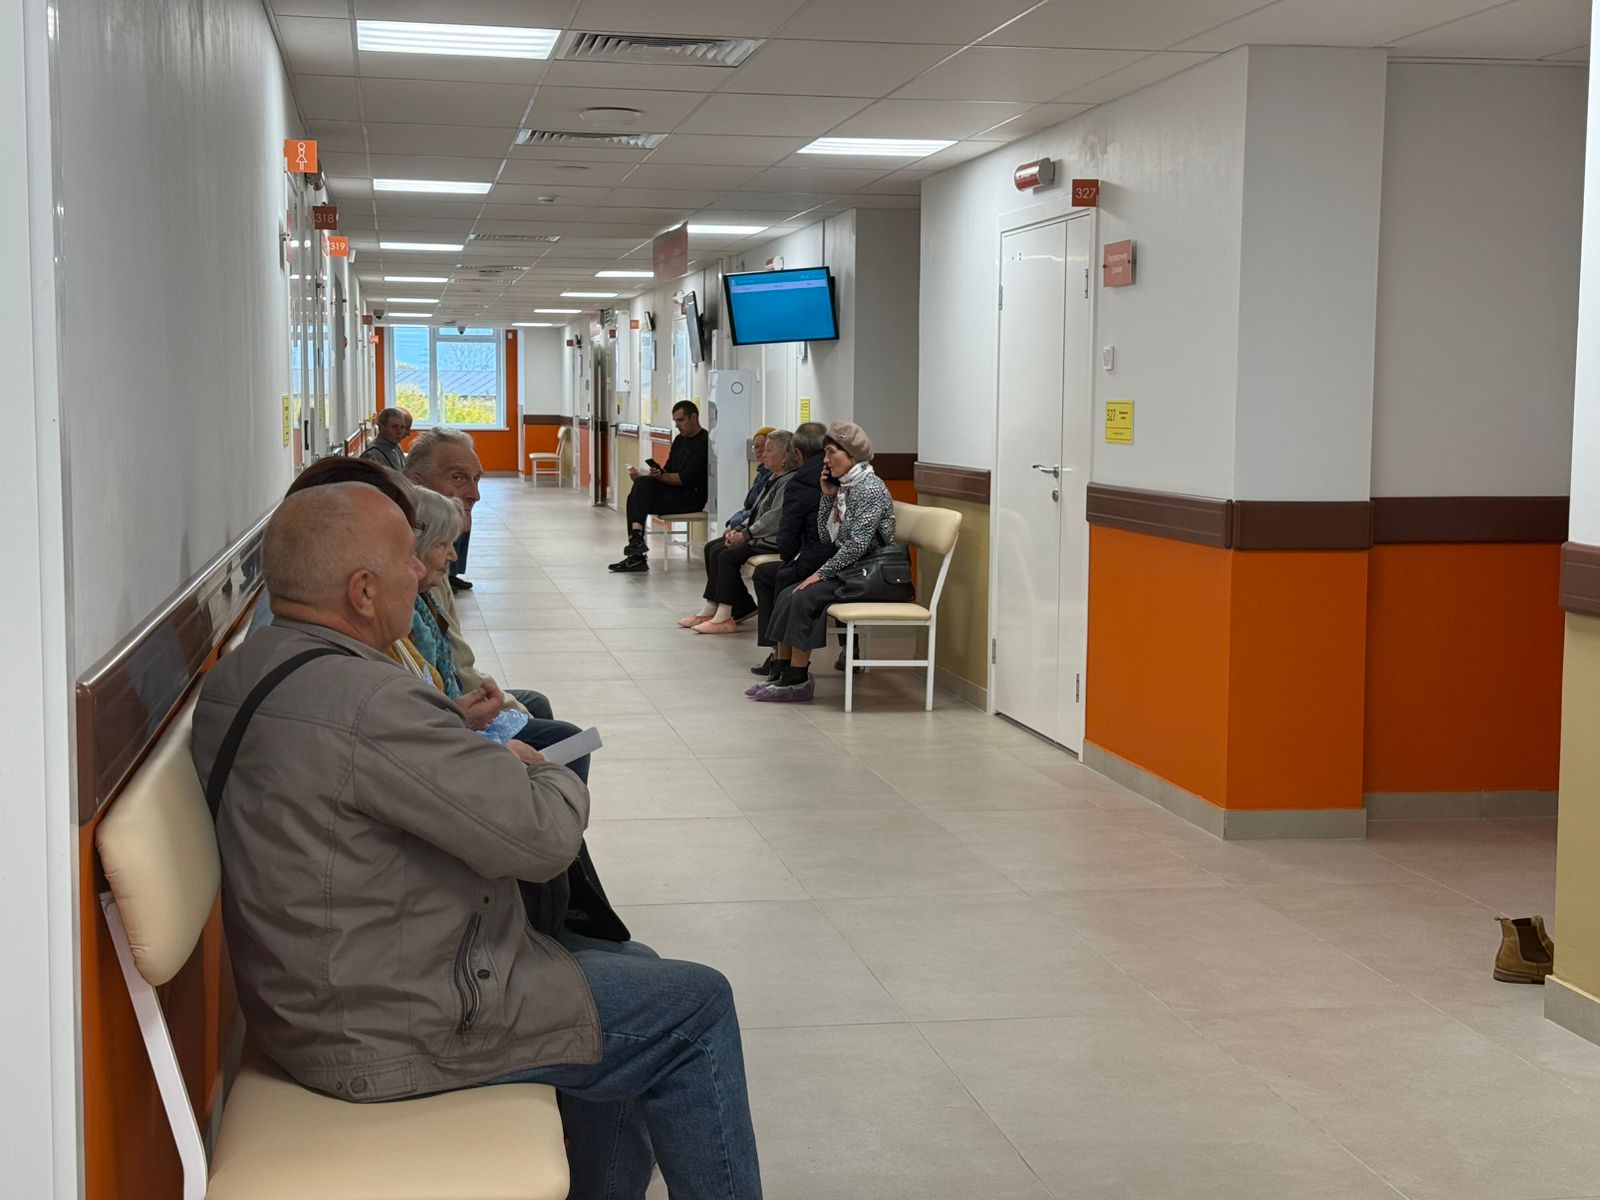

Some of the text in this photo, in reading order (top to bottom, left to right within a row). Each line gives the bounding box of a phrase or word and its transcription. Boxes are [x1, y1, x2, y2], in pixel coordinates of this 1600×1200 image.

[1074, 187, 1097, 199] 327
[315, 213, 334, 223] 318
[329, 241, 346, 251] 319
[1106, 408, 1116, 421] 327
